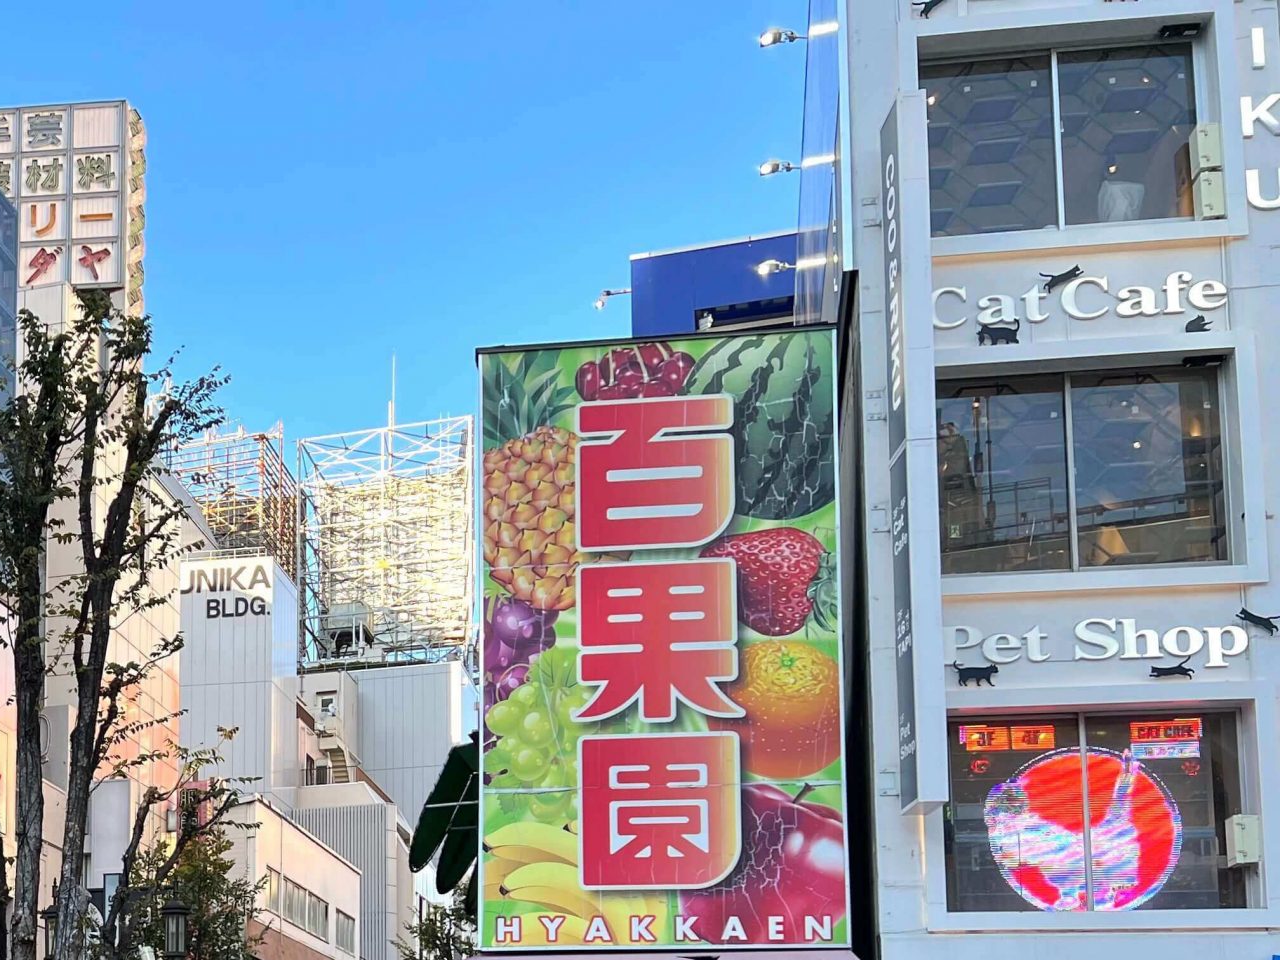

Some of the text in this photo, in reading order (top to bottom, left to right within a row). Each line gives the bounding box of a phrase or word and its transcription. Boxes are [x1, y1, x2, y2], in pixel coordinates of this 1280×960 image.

[886, 153, 903, 412] COO & RIKU
[931, 270, 1228, 329] Cat Cafe
[206, 596, 271, 619] BLDG.
[570, 393, 747, 891] 百果園
[944, 617, 1250, 668] Pet Shop
[494, 914, 835, 943] HYAKKAEN
